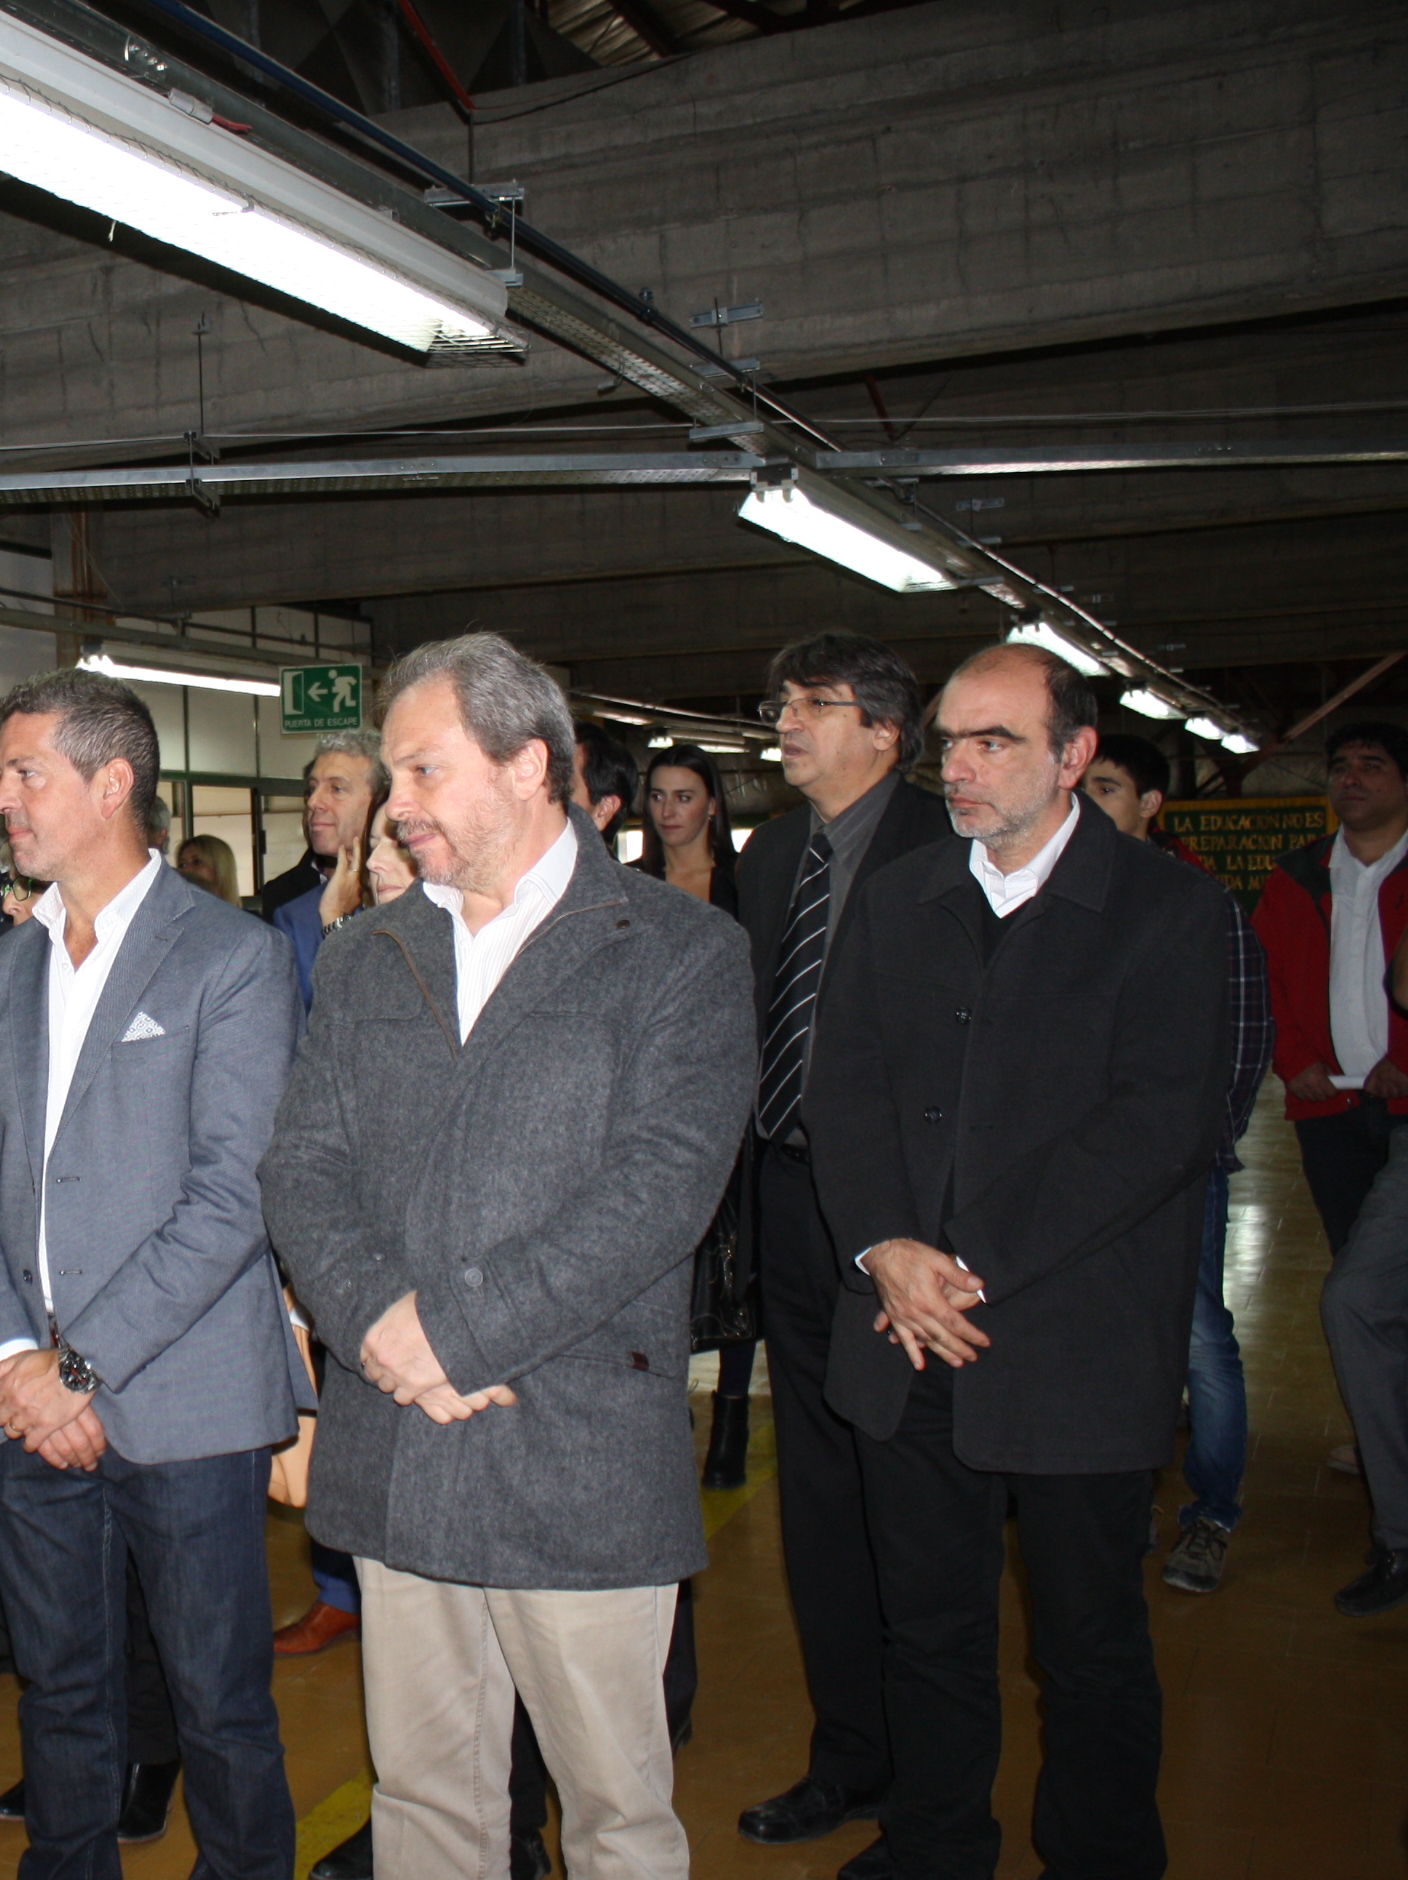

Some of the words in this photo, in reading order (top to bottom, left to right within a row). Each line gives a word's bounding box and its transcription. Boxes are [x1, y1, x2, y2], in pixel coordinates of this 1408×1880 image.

[284, 719, 312, 728] PUERTA
[314, 718, 325, 727] DE
[327, 717, 358, 726] ESCAPE
[1173, 816, 1195, 833] LA
[1282, 813, 1304, 829] NO
[1305, 811, 1325, 828] ES
[1226, 855, 1245, 871] LA
